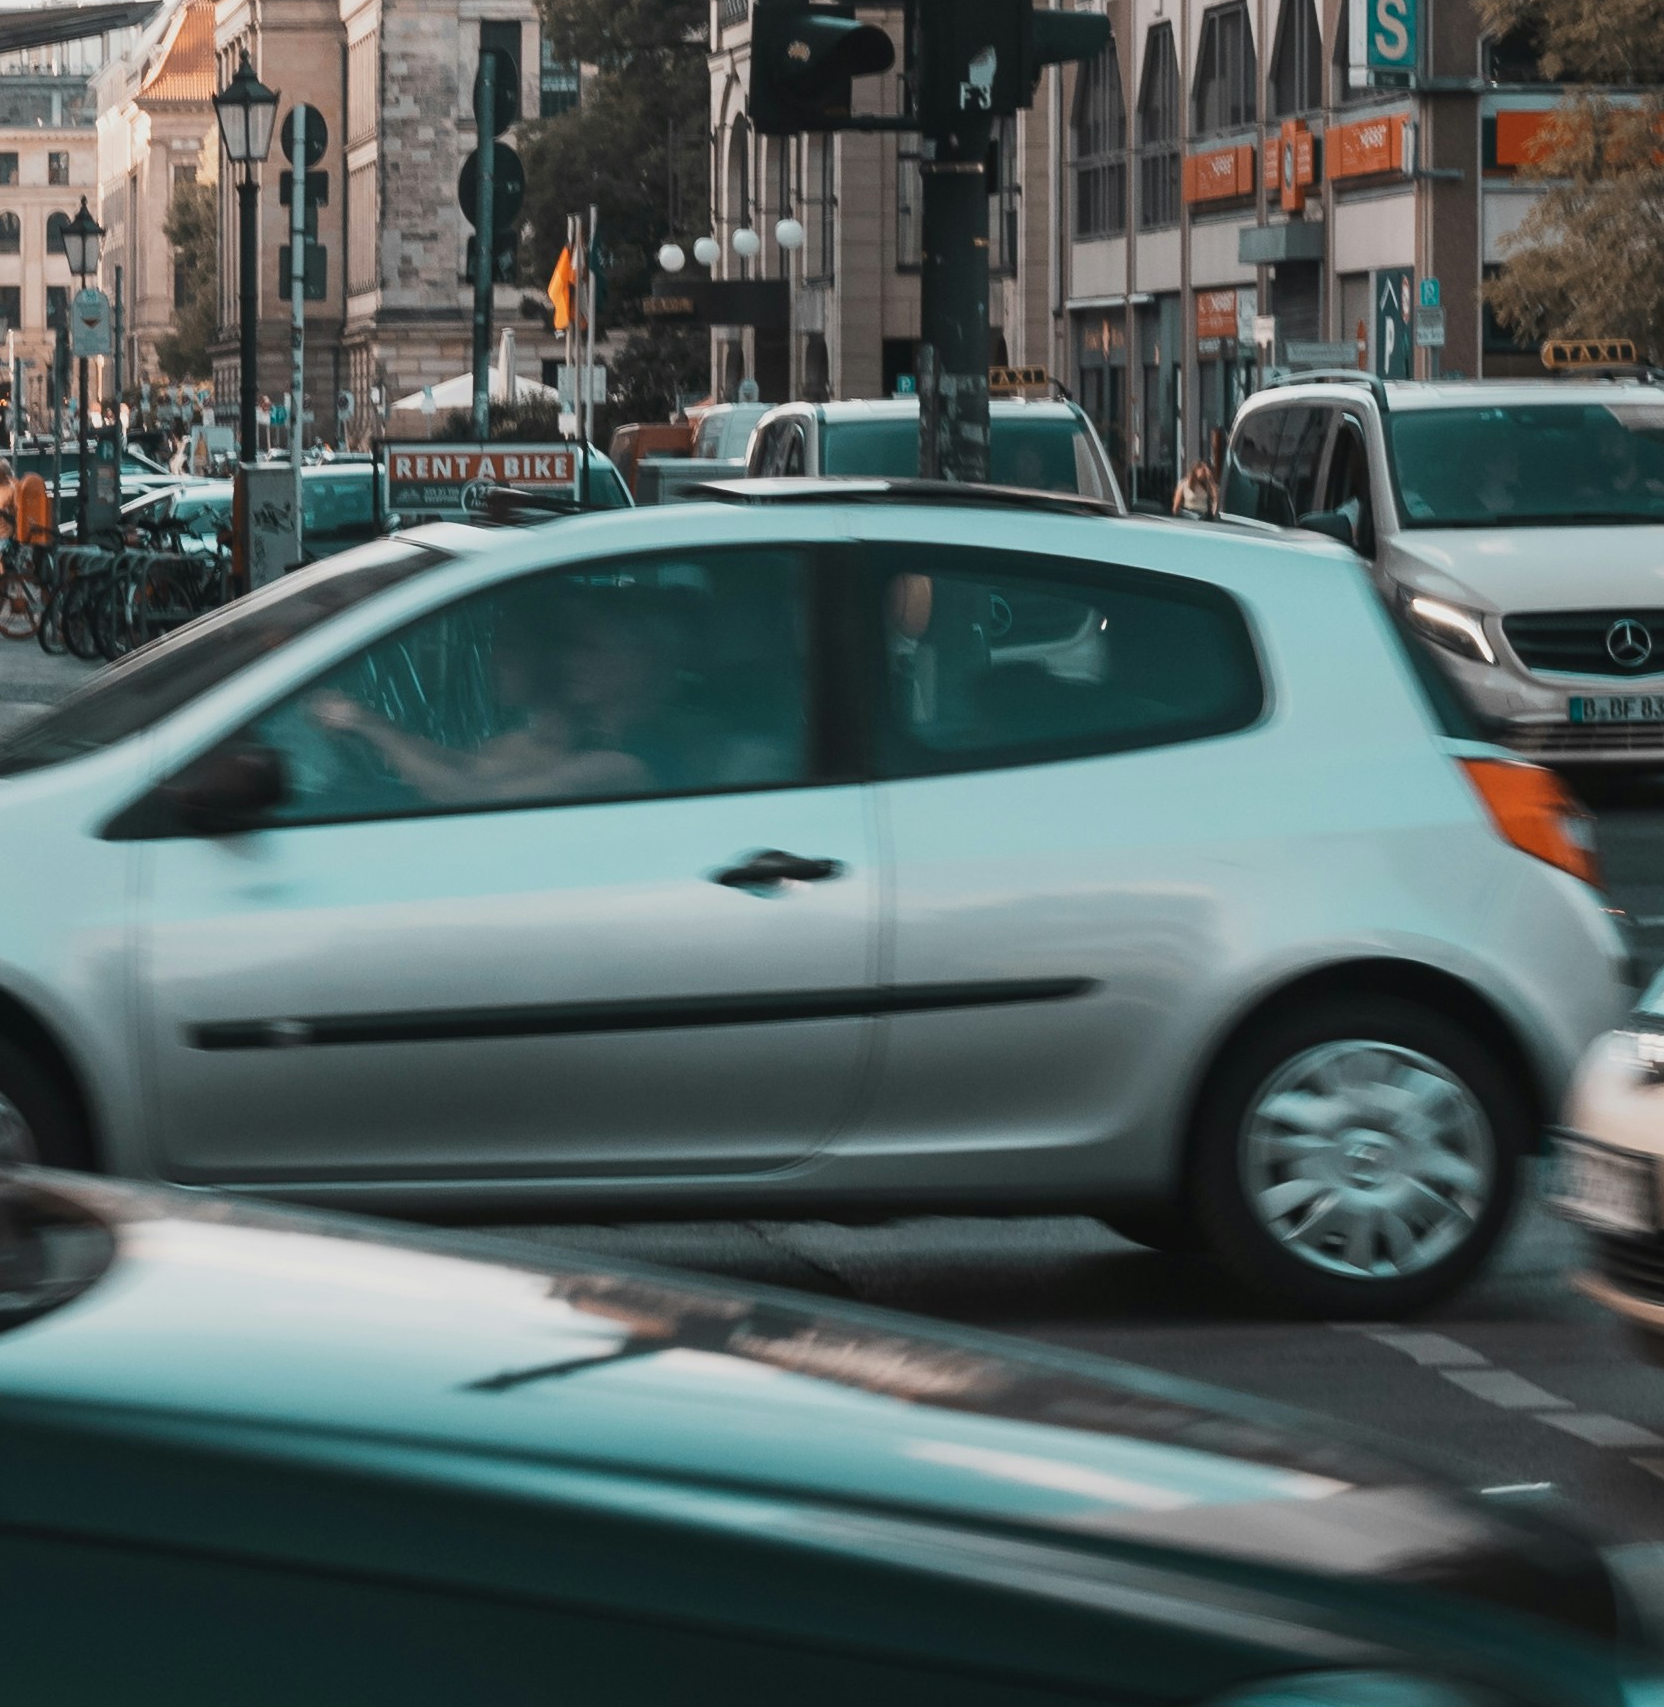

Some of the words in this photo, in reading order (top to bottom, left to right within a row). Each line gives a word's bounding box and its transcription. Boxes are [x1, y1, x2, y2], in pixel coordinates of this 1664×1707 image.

[1560, 343, 1623, 363] TAXI
[395, 455, 471, 480] RENT
[476, 455, 497, 479] A
[503, 454, 568, 479] BIKE
